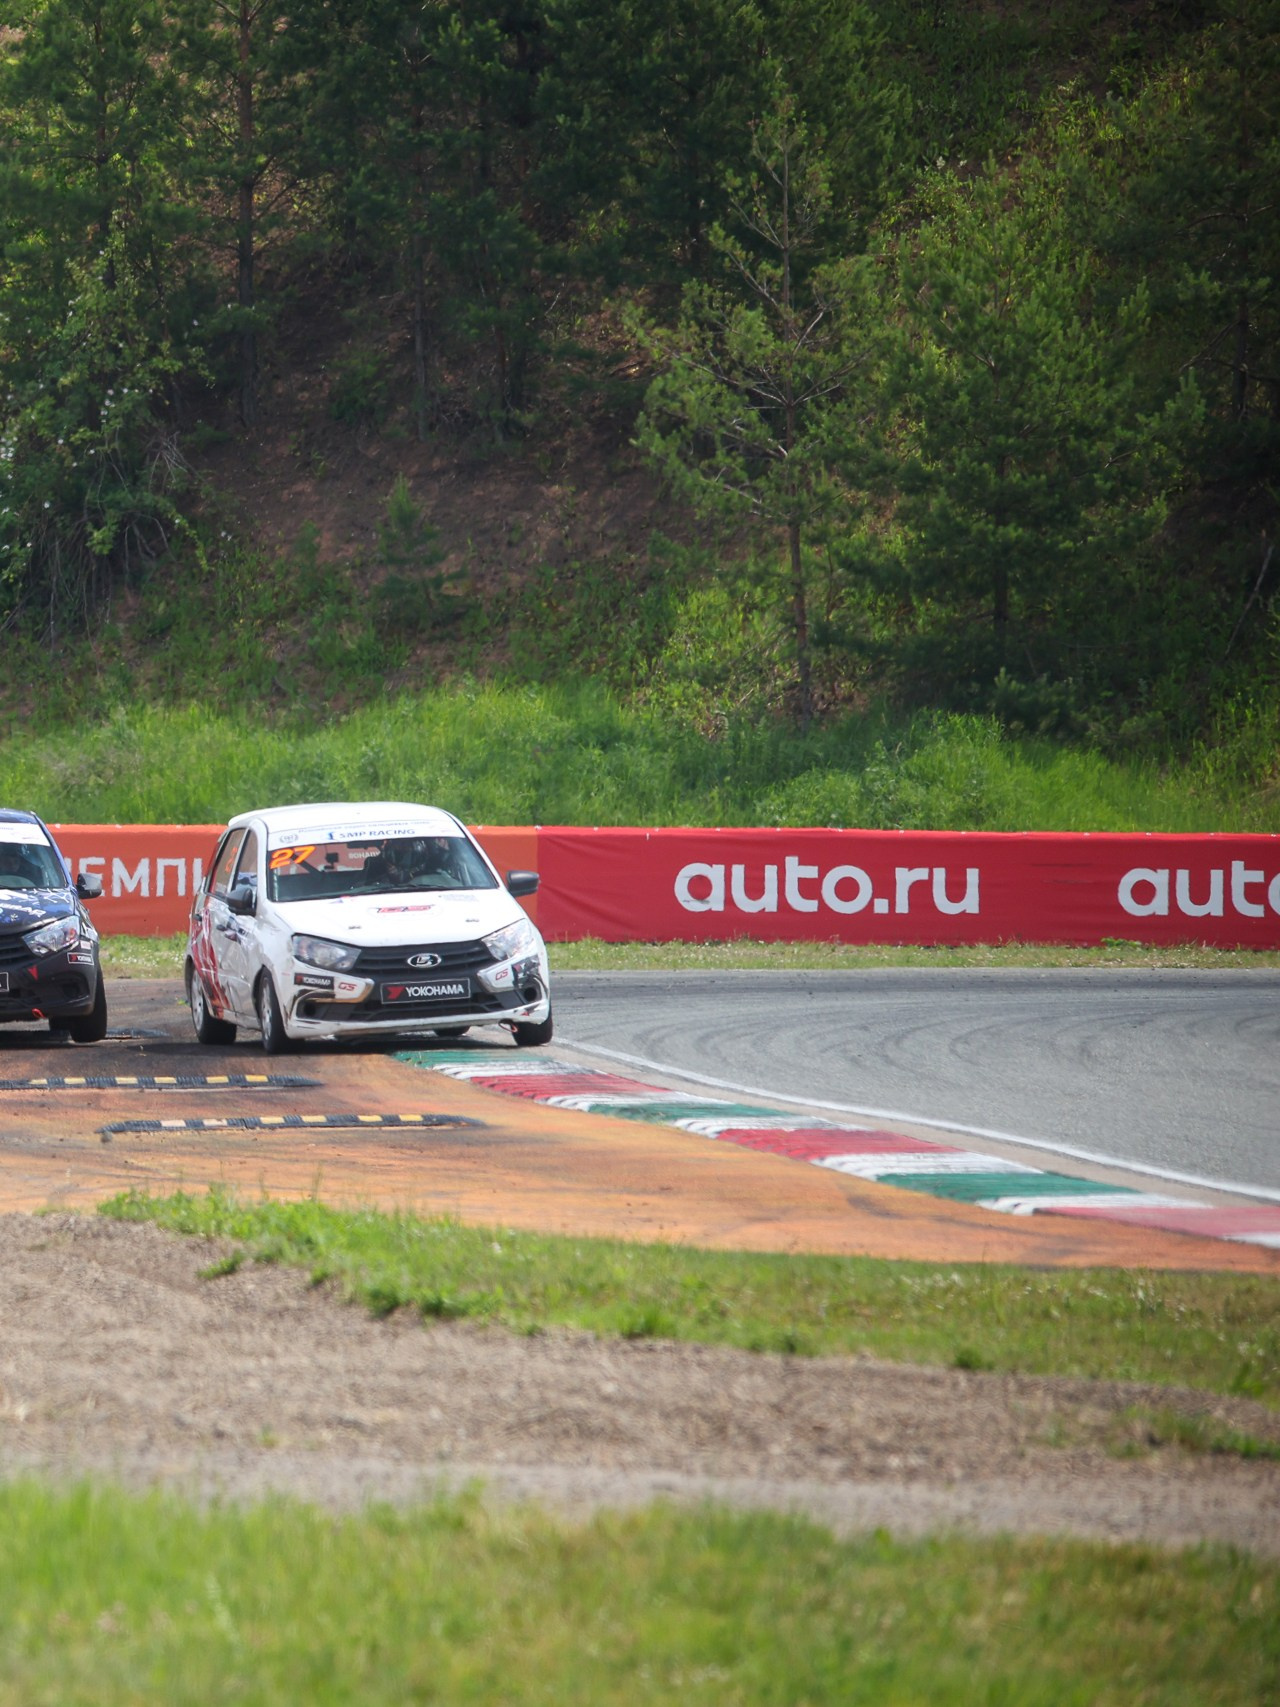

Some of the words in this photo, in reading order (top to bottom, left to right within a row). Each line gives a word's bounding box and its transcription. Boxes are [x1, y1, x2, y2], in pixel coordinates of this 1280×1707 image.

[271, 845, 316, 869] 27
[674, 856, 980, 914] auto.ru
[1117, 860, 1280, 917] aut
[405, 983, 464, 997] YOKOHAMA
